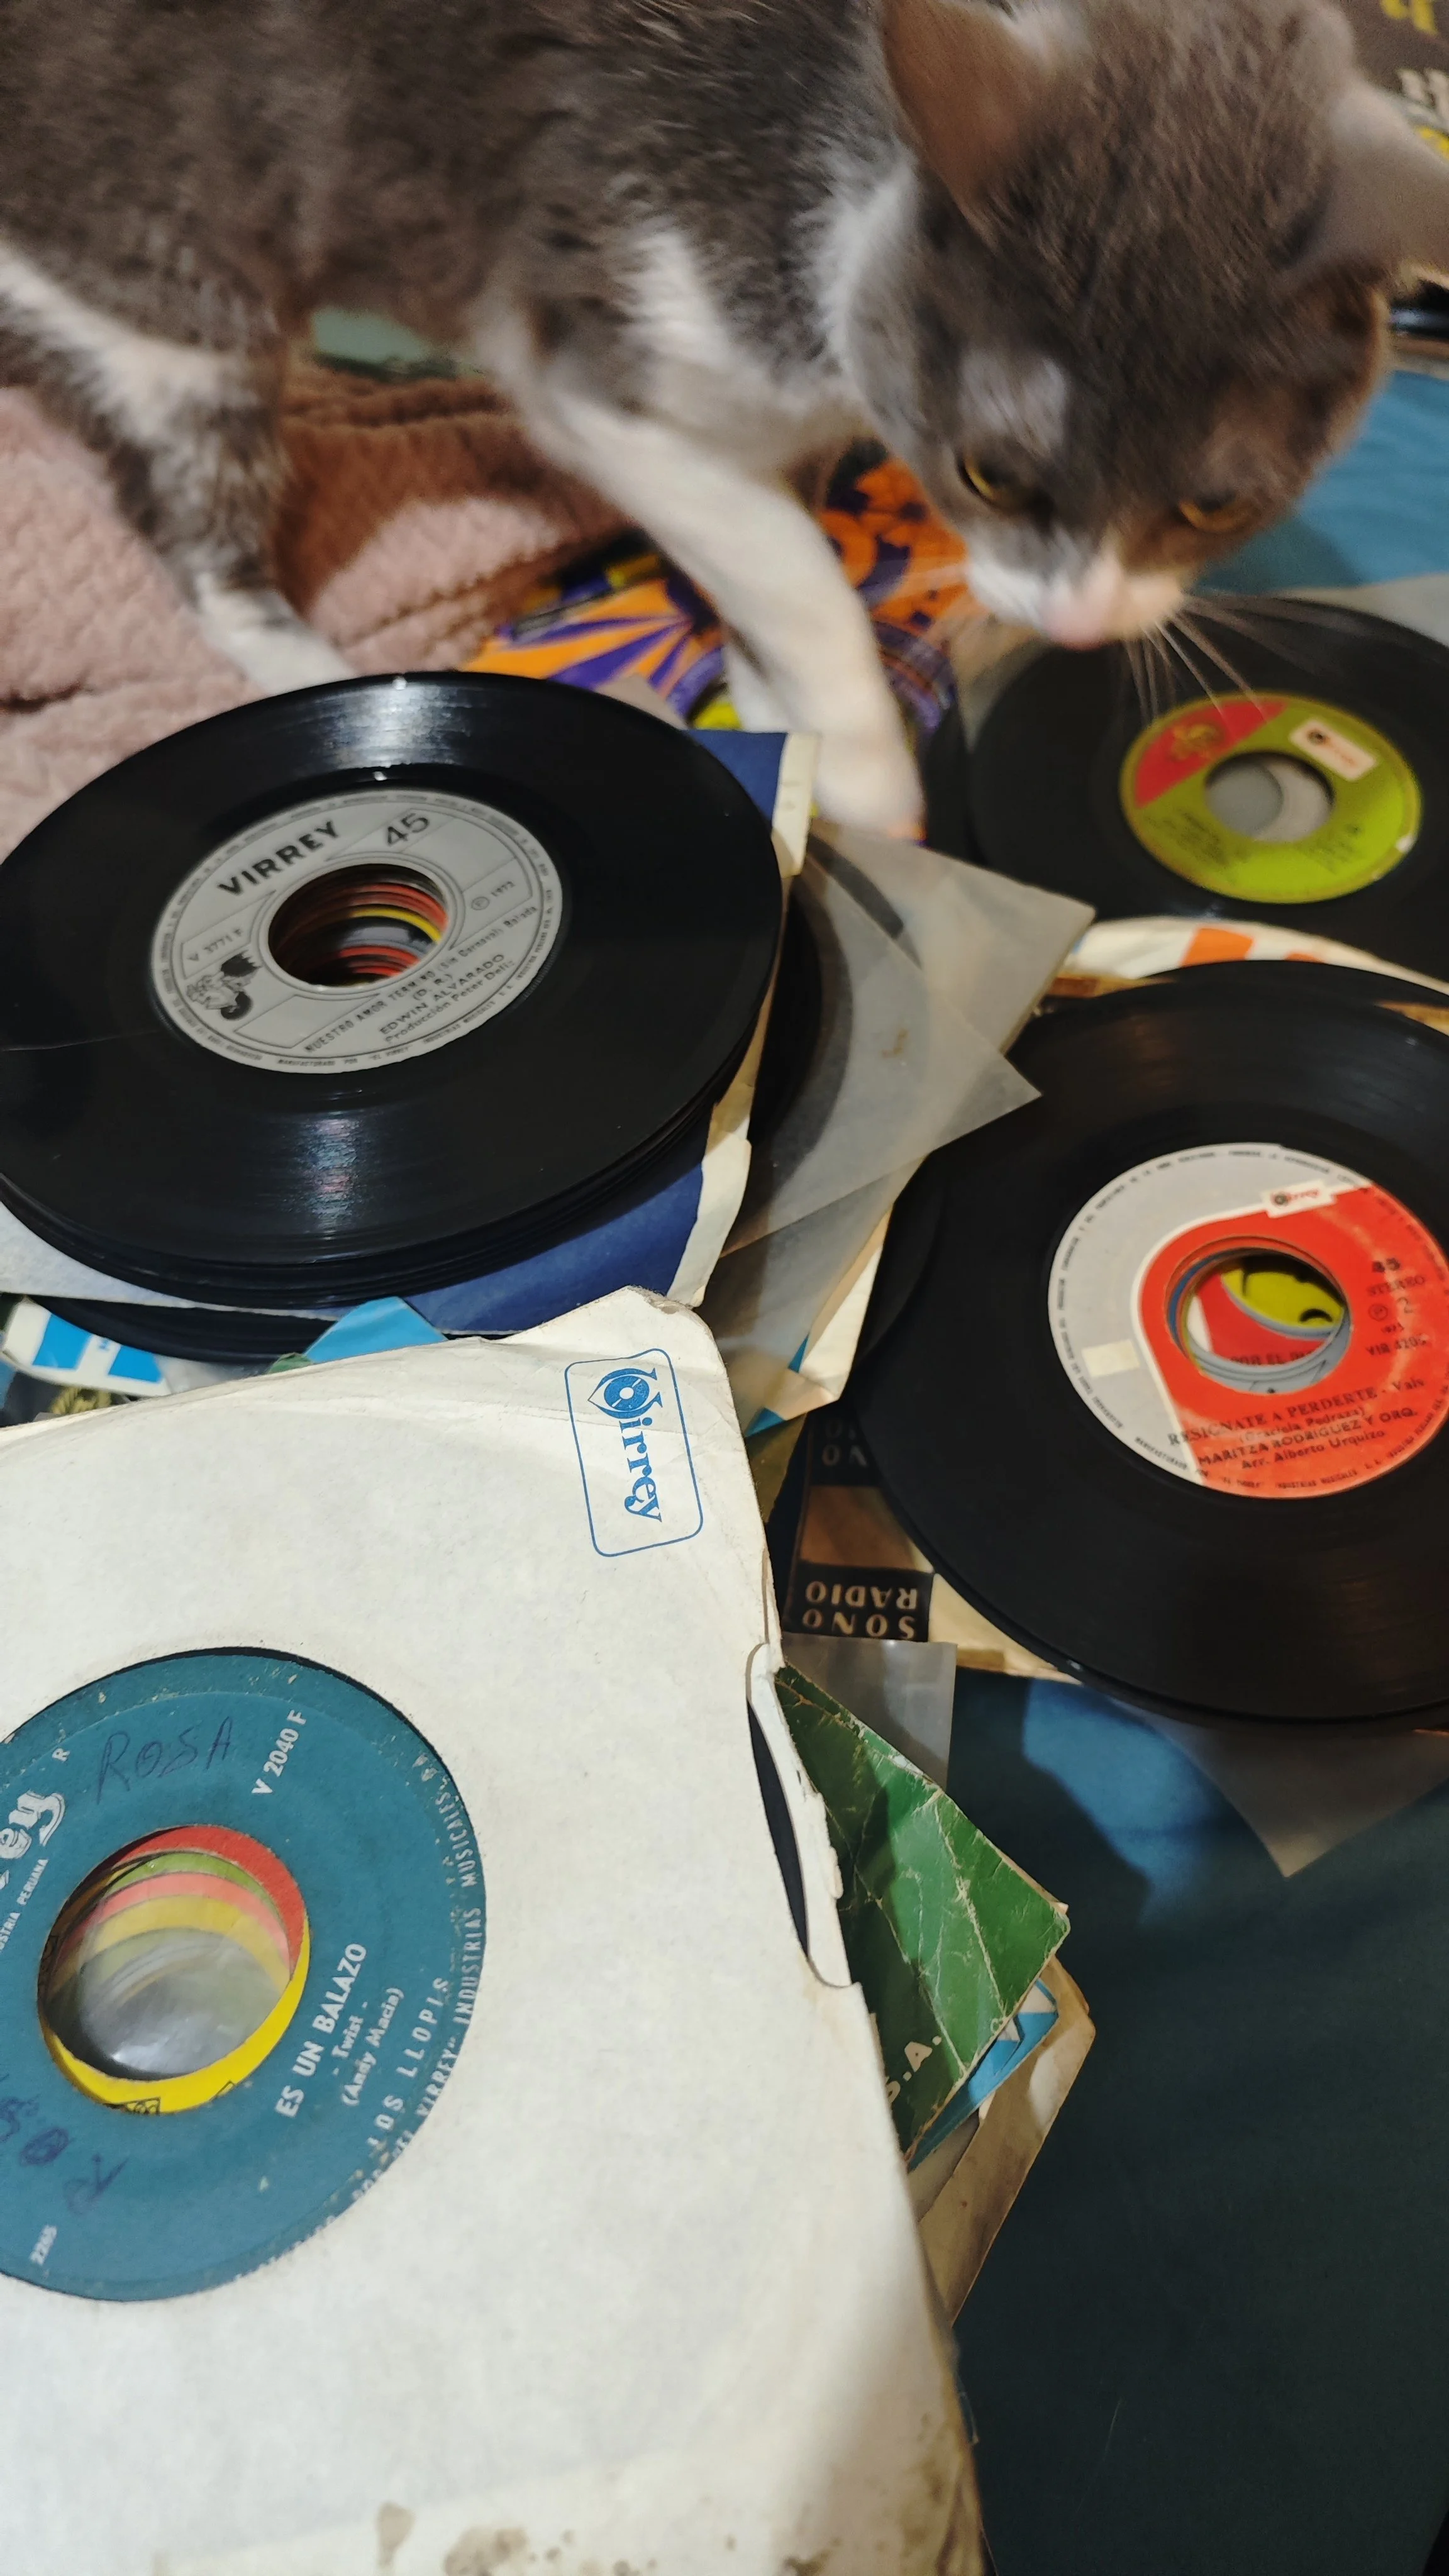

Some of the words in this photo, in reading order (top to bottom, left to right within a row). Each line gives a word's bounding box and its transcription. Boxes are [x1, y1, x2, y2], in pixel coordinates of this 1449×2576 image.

[218, 819, 339, 895] VIRREY
[386, 813, 430, 847] 45
[379, 1002, 428, 1035] EDWIN
[433, 954, 504, 1001] ALVARADO
[385, 1001, 452, 1043] Producción
[450, 979, 484, 1002] Peter
[304, 1019, 354, 1053] NUESTRO
[355, 1000, 388, 1022] AMOR
[1367, 1275, 1425, 1296] STEREO
[1167, 1413, 1267, 1446] RESIGNATE
[1272, 1411, 1282, 1421] A
[1287, 1387, 1377, 1418] PERDERTE
[1392, 1377, 1424, 1392] Vals
[1197, 1443, 1269, 1465] MARITZA
[1271, 1419, 1362, 1448] RODRIGUEZ
[1365, 1414, 1374, 1425] Y
[1379, 1407, 1418, 1423] ORQ.
[588, 1368, 663, 1523] Virrey
[1275, 1445, 1324, 1462] Alberto
[1328, 1430, 1385, 1448] Urquizo
[802, 1608, 915, 1640] SONO
[805, 1580, 918, 1609] RADIO
[96, 1716, 233, 1805] ROSA
[252, 1778, 273, 1794] V
[263, 1728, 299, 1777] 2040
[287, 1709, 307, 1725] F
[16, 1859, 48, 1906] PERUANA
[453, 1906, 482, 2025] INDUSTRIAS
[275, 2085, 304, 2118] ES
[292, 2040, 325, 2077] UN
[312, 1943, 367, 2034] BALAZO
[332, 2015, 364, 2058] Twist
[396, 1977, 448, 2078] LLOPIS
[341, 2051, 377, 2106] (Andy
